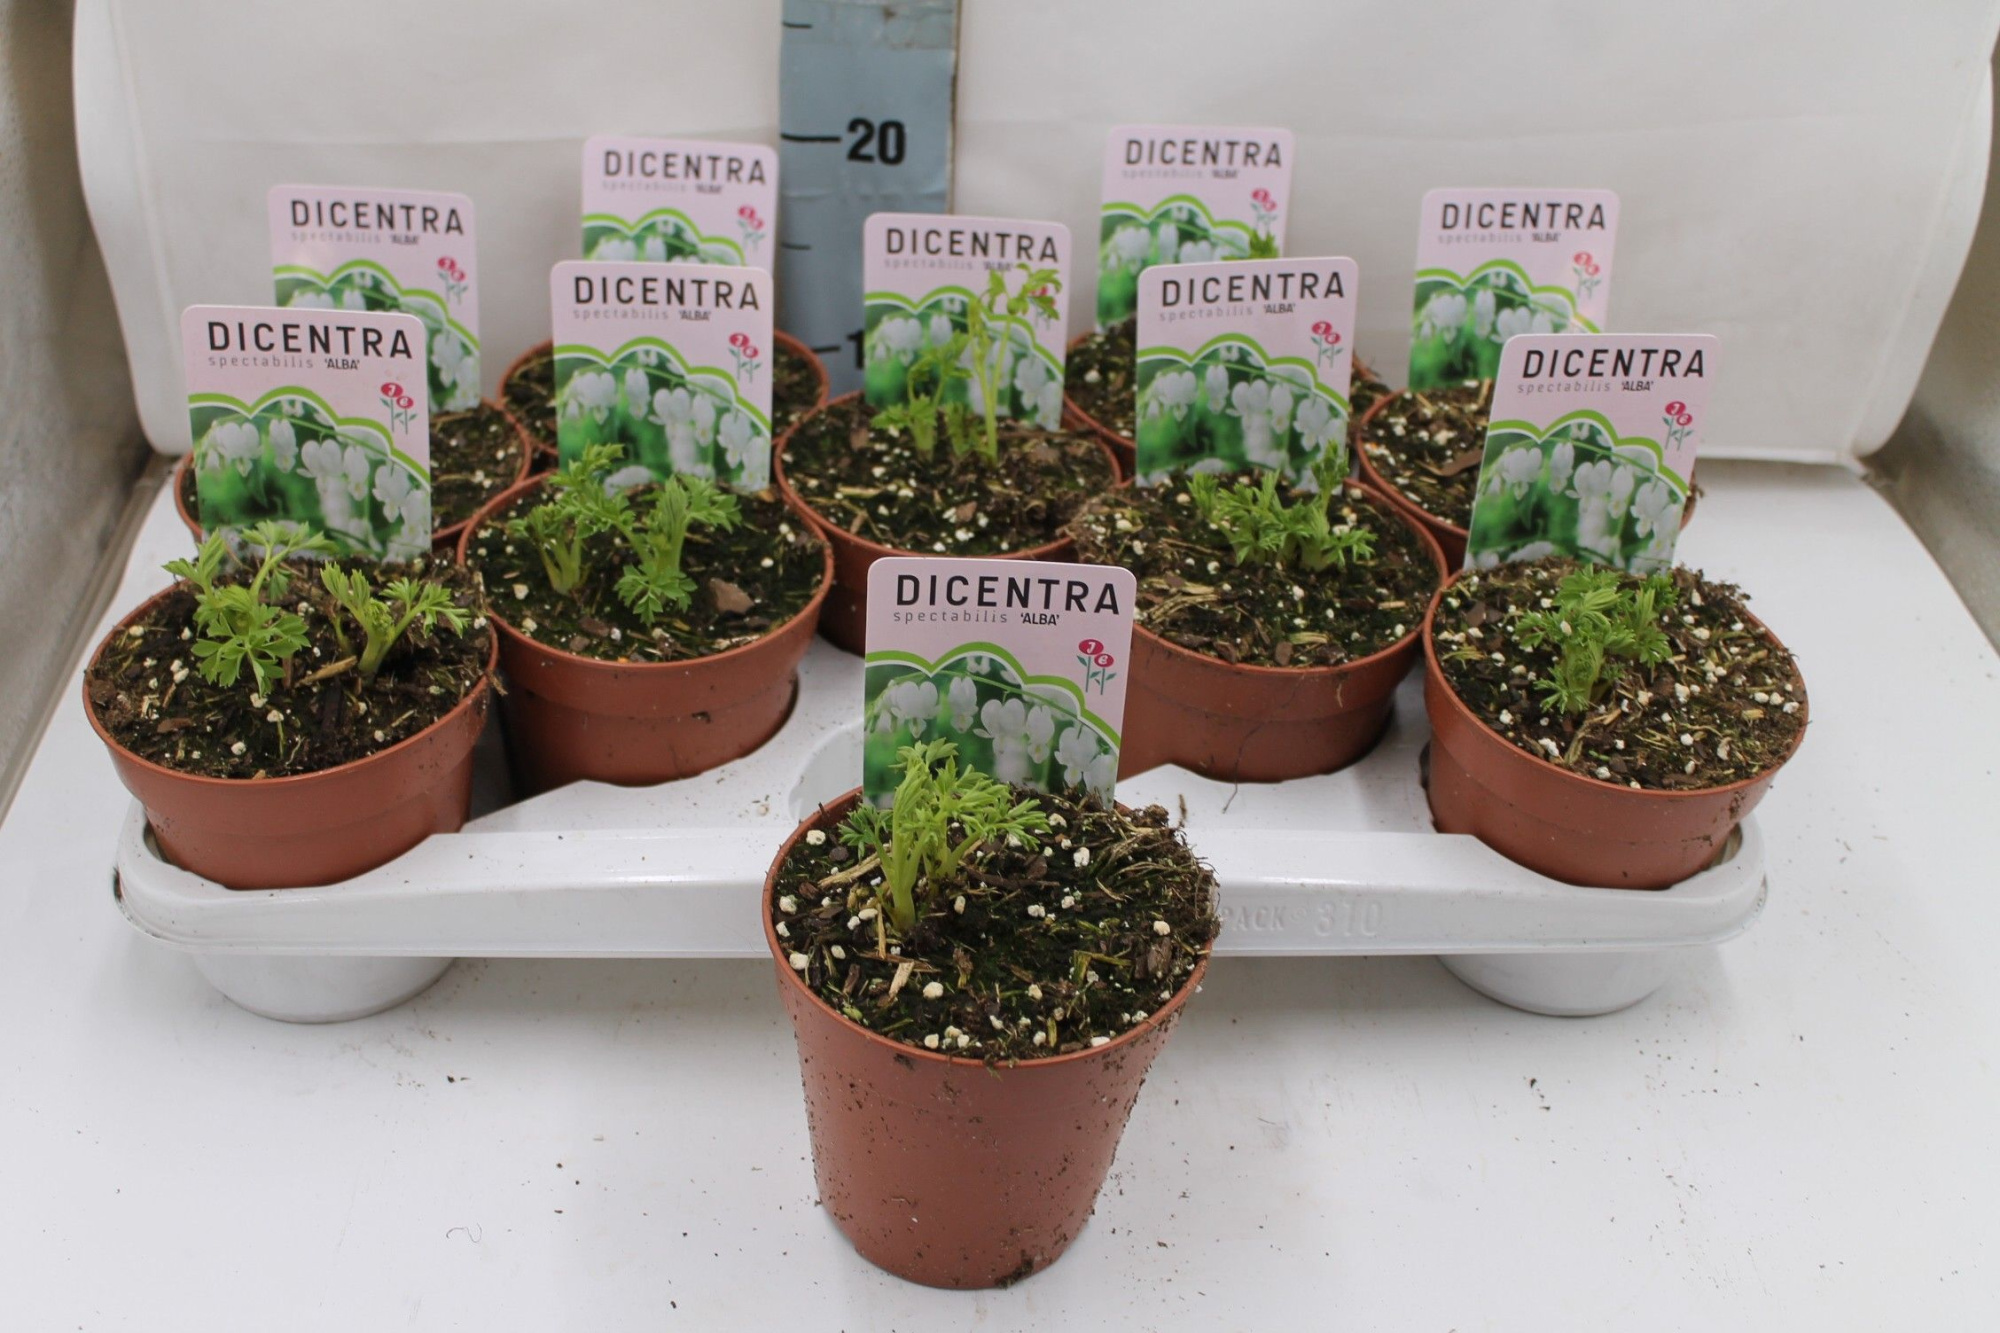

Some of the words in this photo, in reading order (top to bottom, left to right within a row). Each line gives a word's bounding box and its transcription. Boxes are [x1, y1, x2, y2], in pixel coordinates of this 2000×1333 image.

[846, 117, 907, 166] 20
[1125, 139, 1282, 168] DICENTRA
[603, 150, 766, 185] DICENTRA
[291, 200, 465, 235] DICENTRA
[1441, 203, 1606, 230] DICENTRA
[885, 228, 1060, 263] DICENTRA
[573, 276, 760, 311] DICENTRA
[1162, 271, 1345, 307] DICENTRA
[572, 308, 669, 321] spectabilis
[1159, 306, 1254, 323] spectabilis
[207, 321, 413, 359] DICENTRA
[207, 355, 314, 369] spectabilis
[1522, 349, 1704, 378] DICENTRA
[1516, 381, 1611, 395] spectabilis
[896, 574, 1120, 615] DICENTRA
[892, 609, 1008, 625] spectabilis
